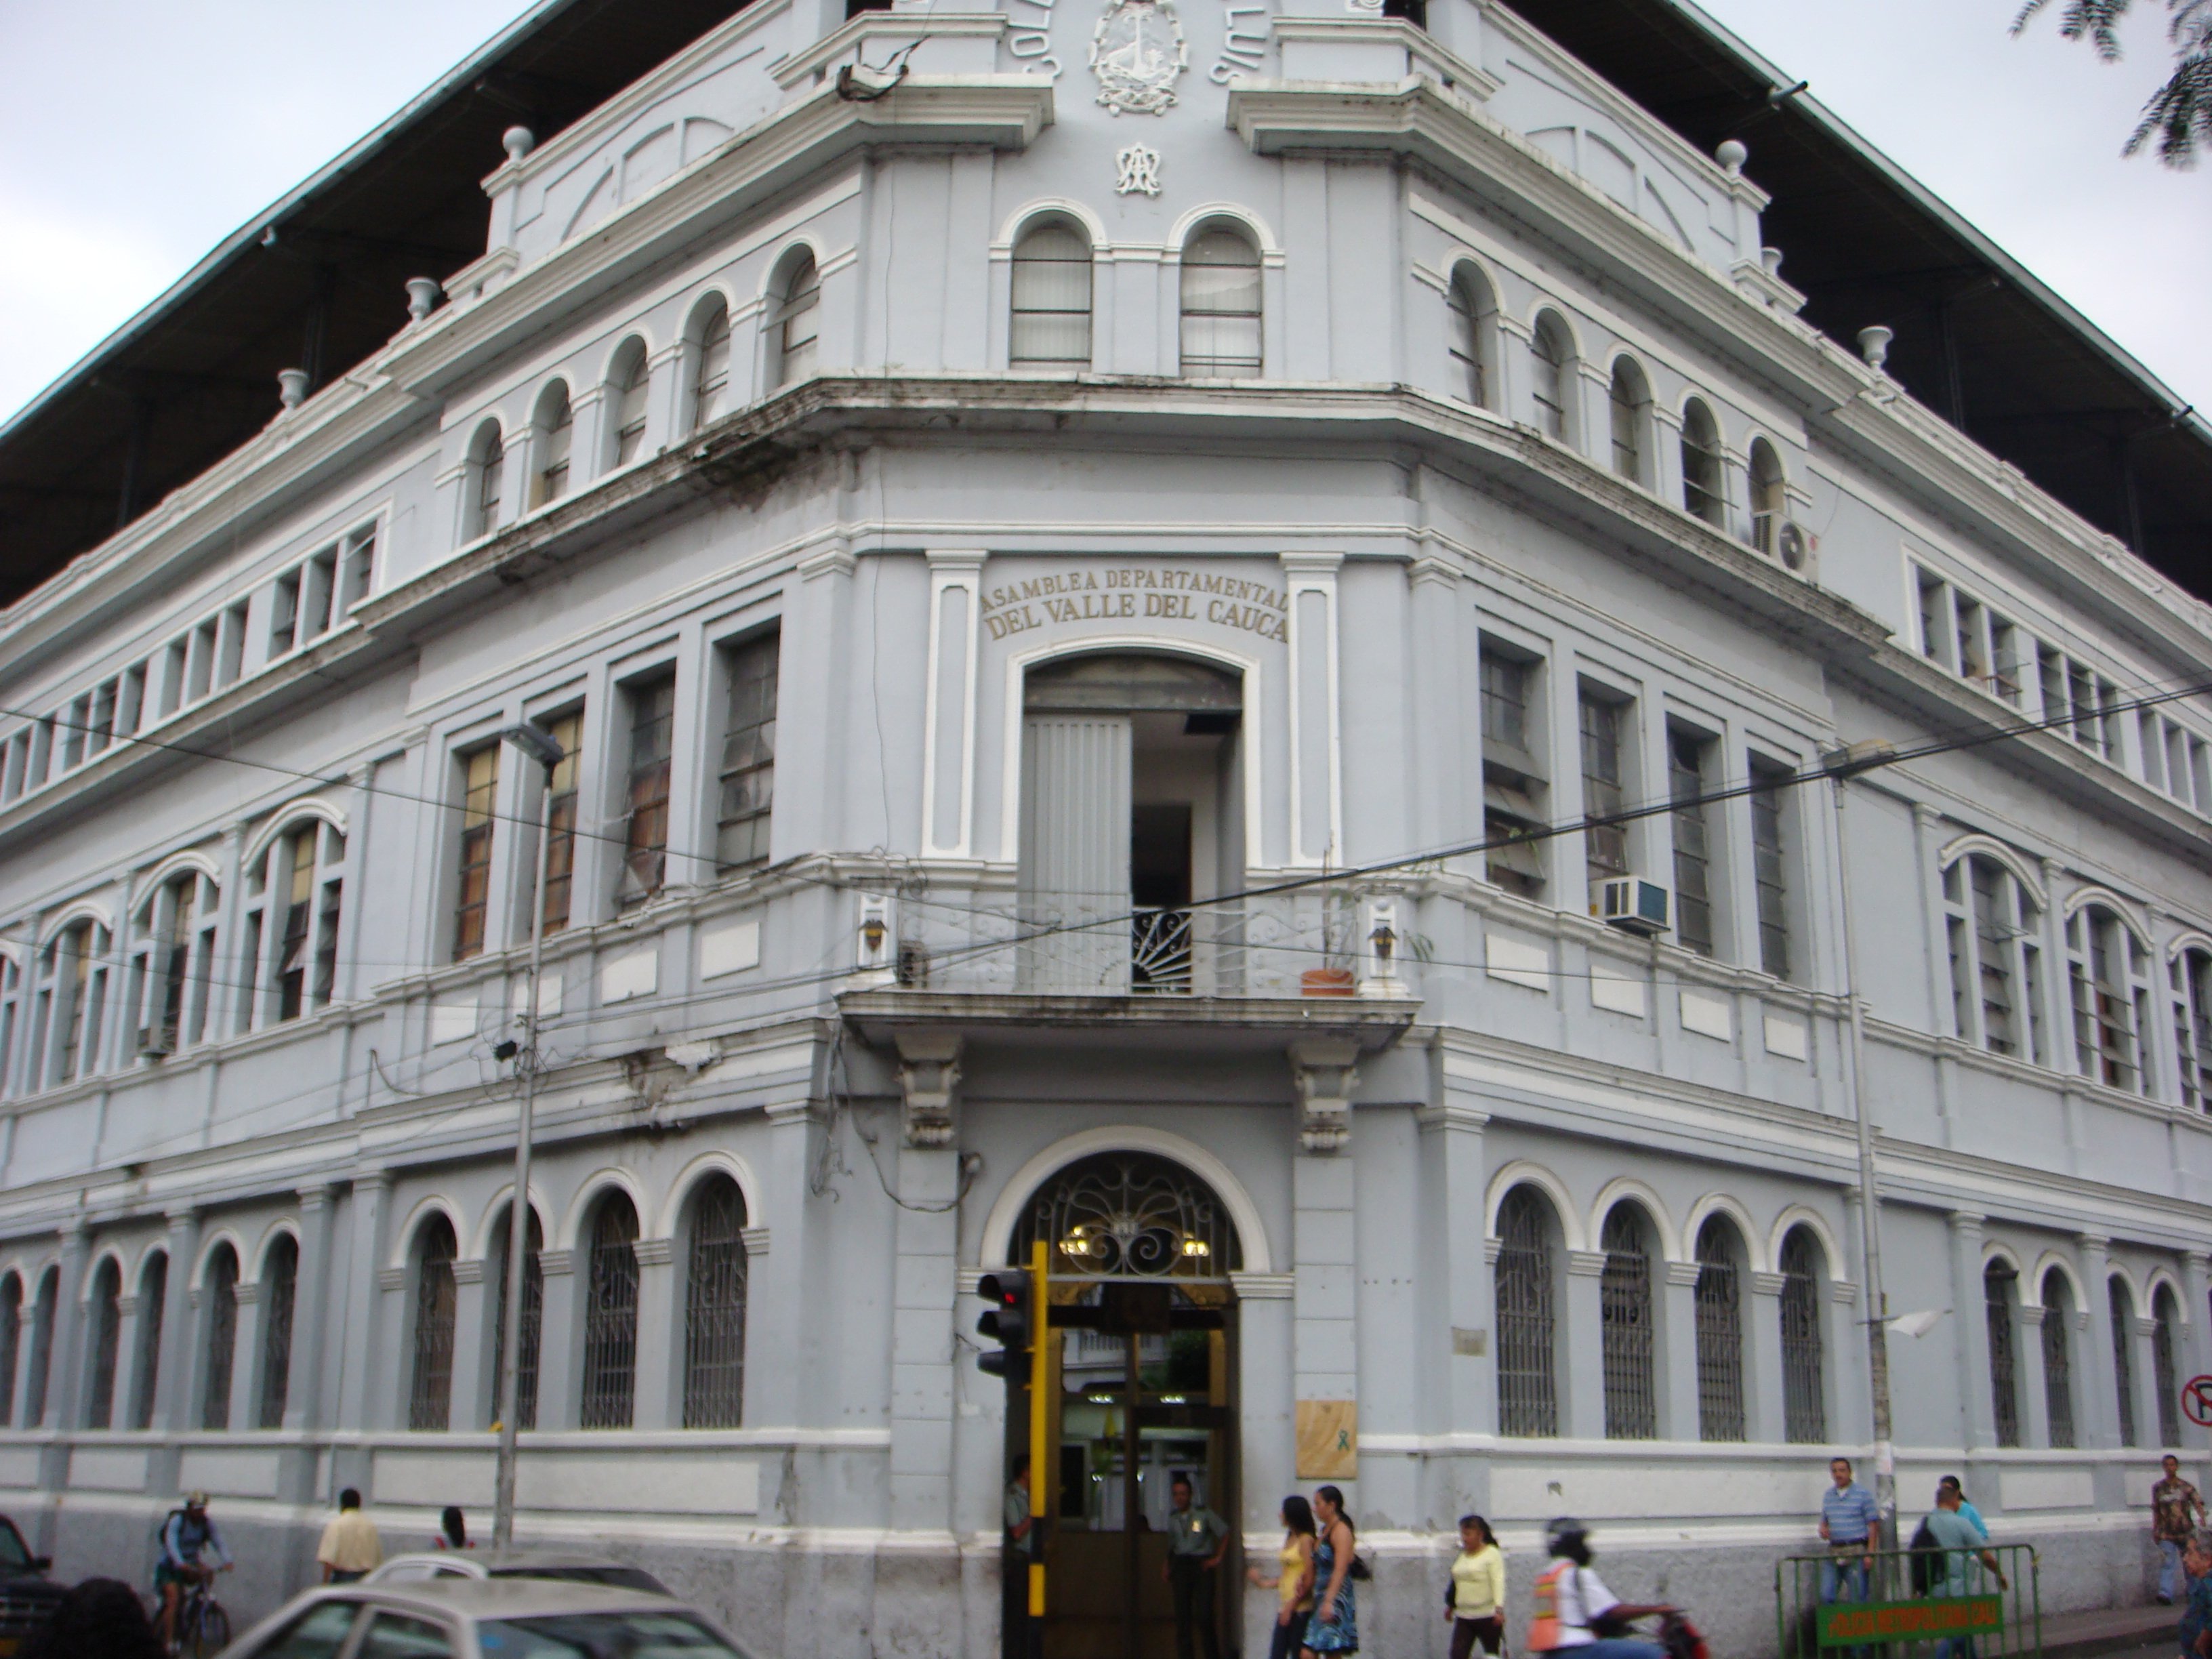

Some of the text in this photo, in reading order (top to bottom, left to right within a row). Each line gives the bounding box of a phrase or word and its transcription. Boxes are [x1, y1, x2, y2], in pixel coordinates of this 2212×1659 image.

[981, 569, 1288, 613] ASAMBLEA DEPARTAMENTAL
[985, 593, 1288, 644] DEL VALLE DEL CAUCA
